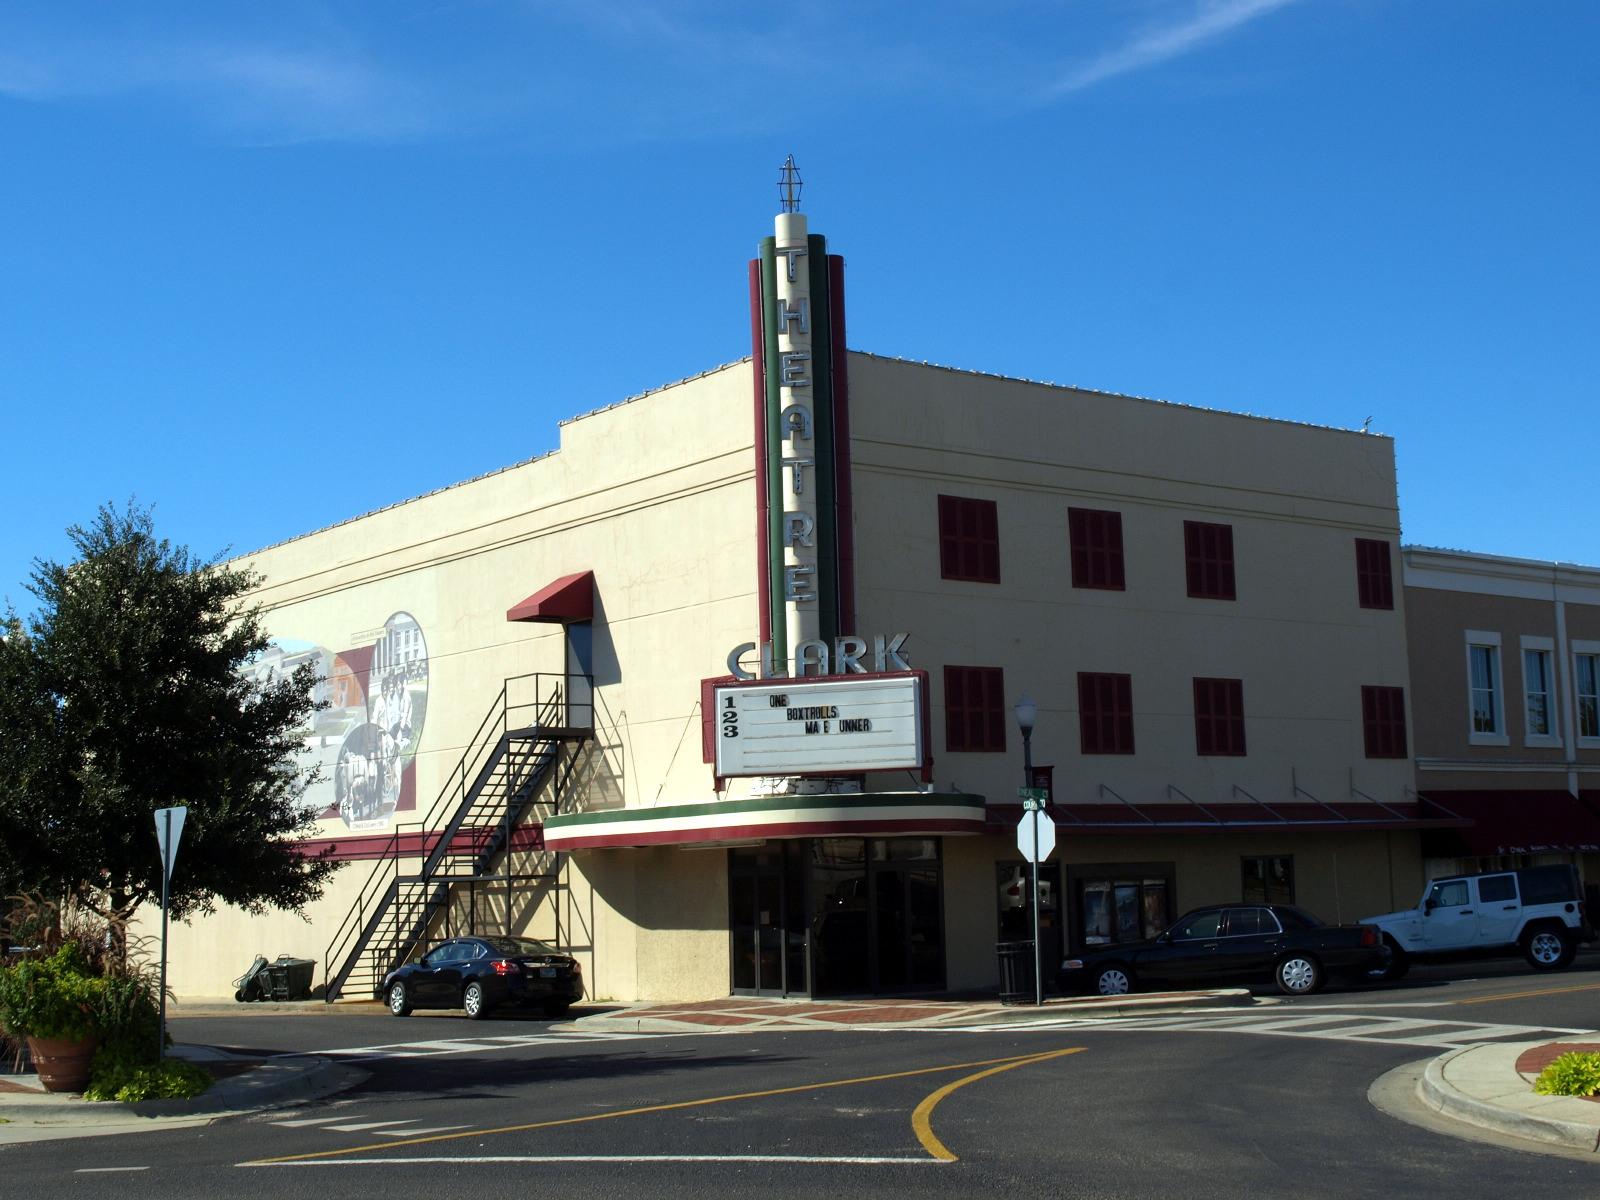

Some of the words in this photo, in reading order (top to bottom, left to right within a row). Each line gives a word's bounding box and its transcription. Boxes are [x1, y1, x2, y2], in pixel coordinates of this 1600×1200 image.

[774, 248, 816, 601] THEATRE
[727, 632, 911, 680] CLARK
[724, 697, 735, 709] 1
[769, 694, 787, 708] ONE
[723, 711, 738, 724] 2
[787, 705, 837, 721] BOXTROLLS
[723, 725, 739, 738] 3
